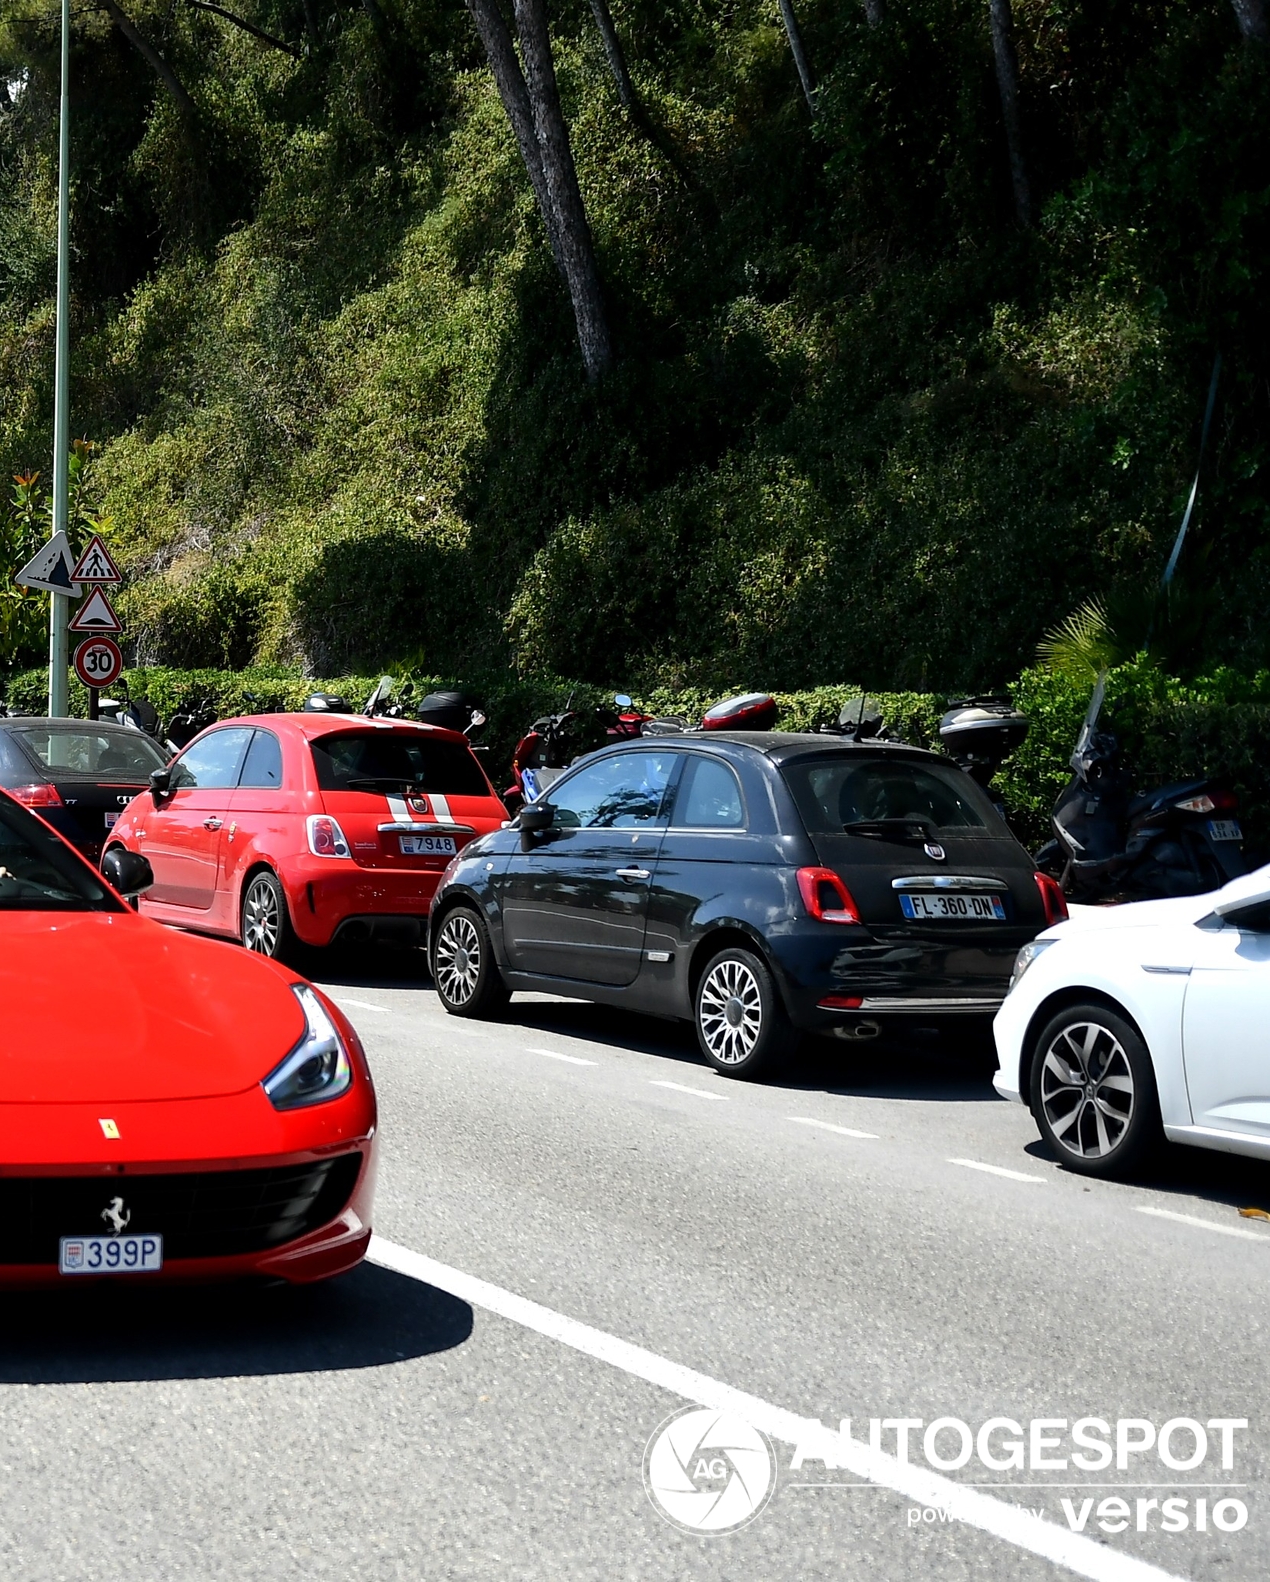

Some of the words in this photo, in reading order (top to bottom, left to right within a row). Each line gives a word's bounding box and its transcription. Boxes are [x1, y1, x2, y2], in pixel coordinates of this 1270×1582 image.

[86, 652, 112, 673] 30
[415, 837, 452, 851] 7948
[88, 1239, 157, 1268] 399P
